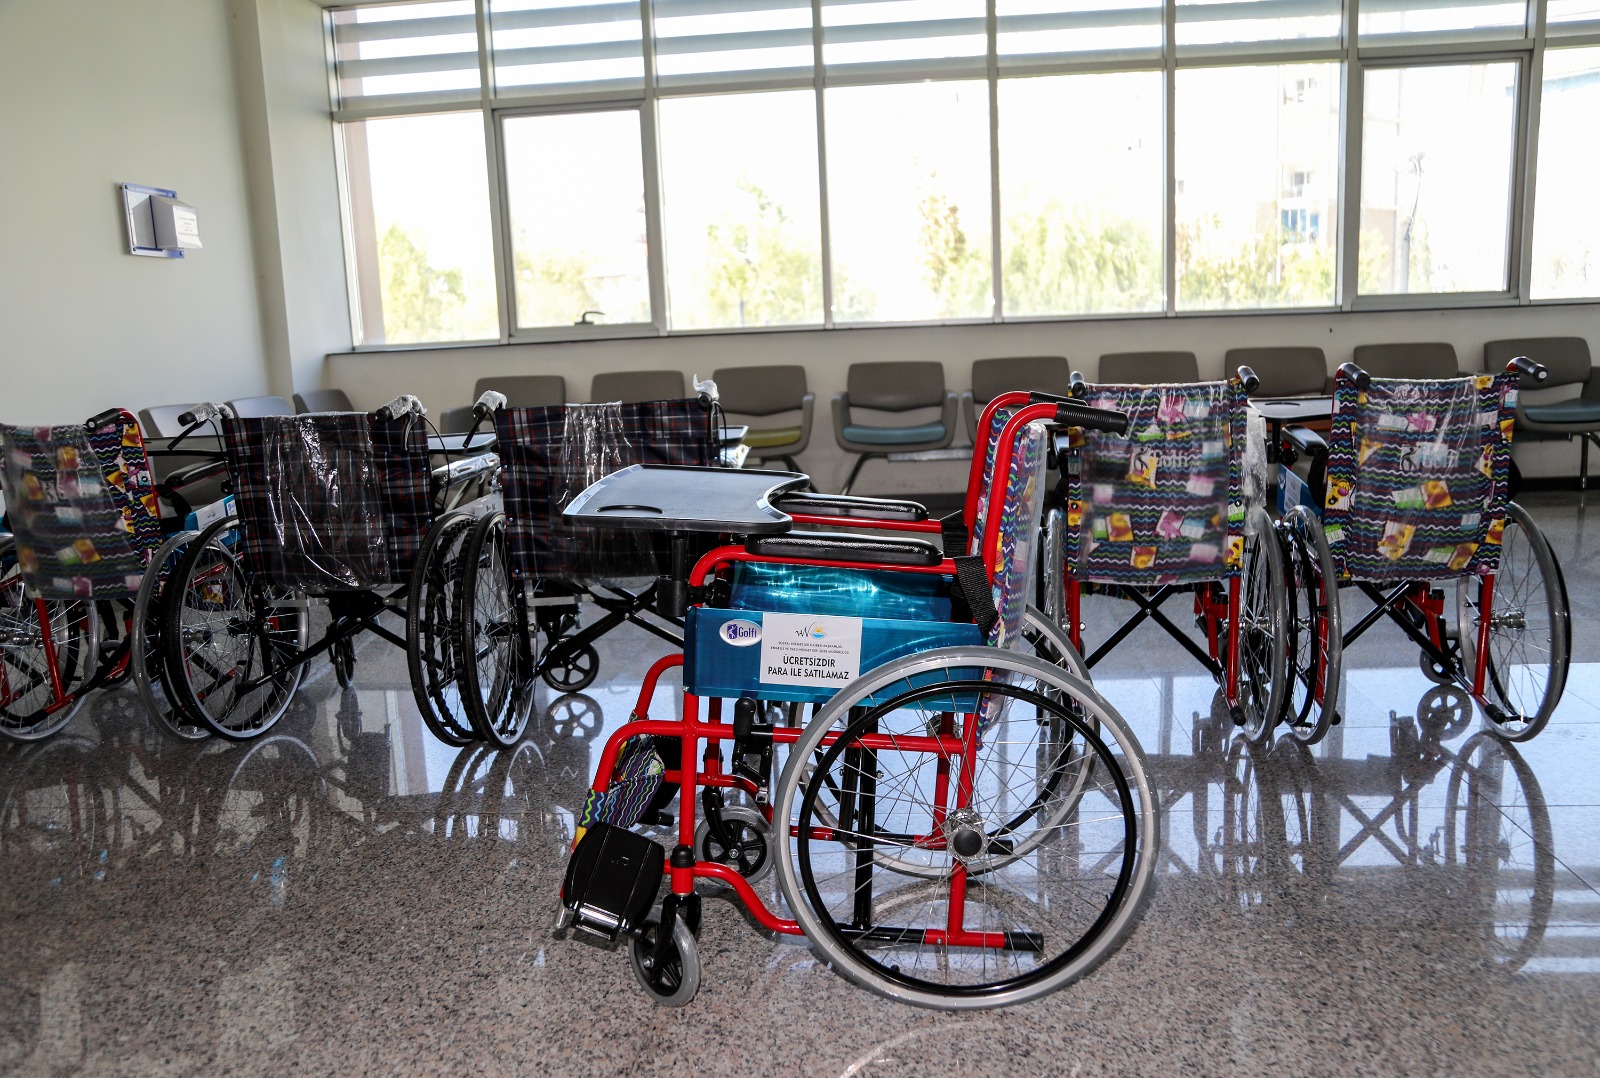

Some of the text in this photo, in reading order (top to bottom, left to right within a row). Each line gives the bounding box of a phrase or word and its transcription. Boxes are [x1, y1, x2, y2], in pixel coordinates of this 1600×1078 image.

[738, 627, 757, 638] Golfi
[783, 653, 836, 668] ÜCRETSİZDİR
[768, 665, 849, 680] PARA İLE SATILAMAZ
